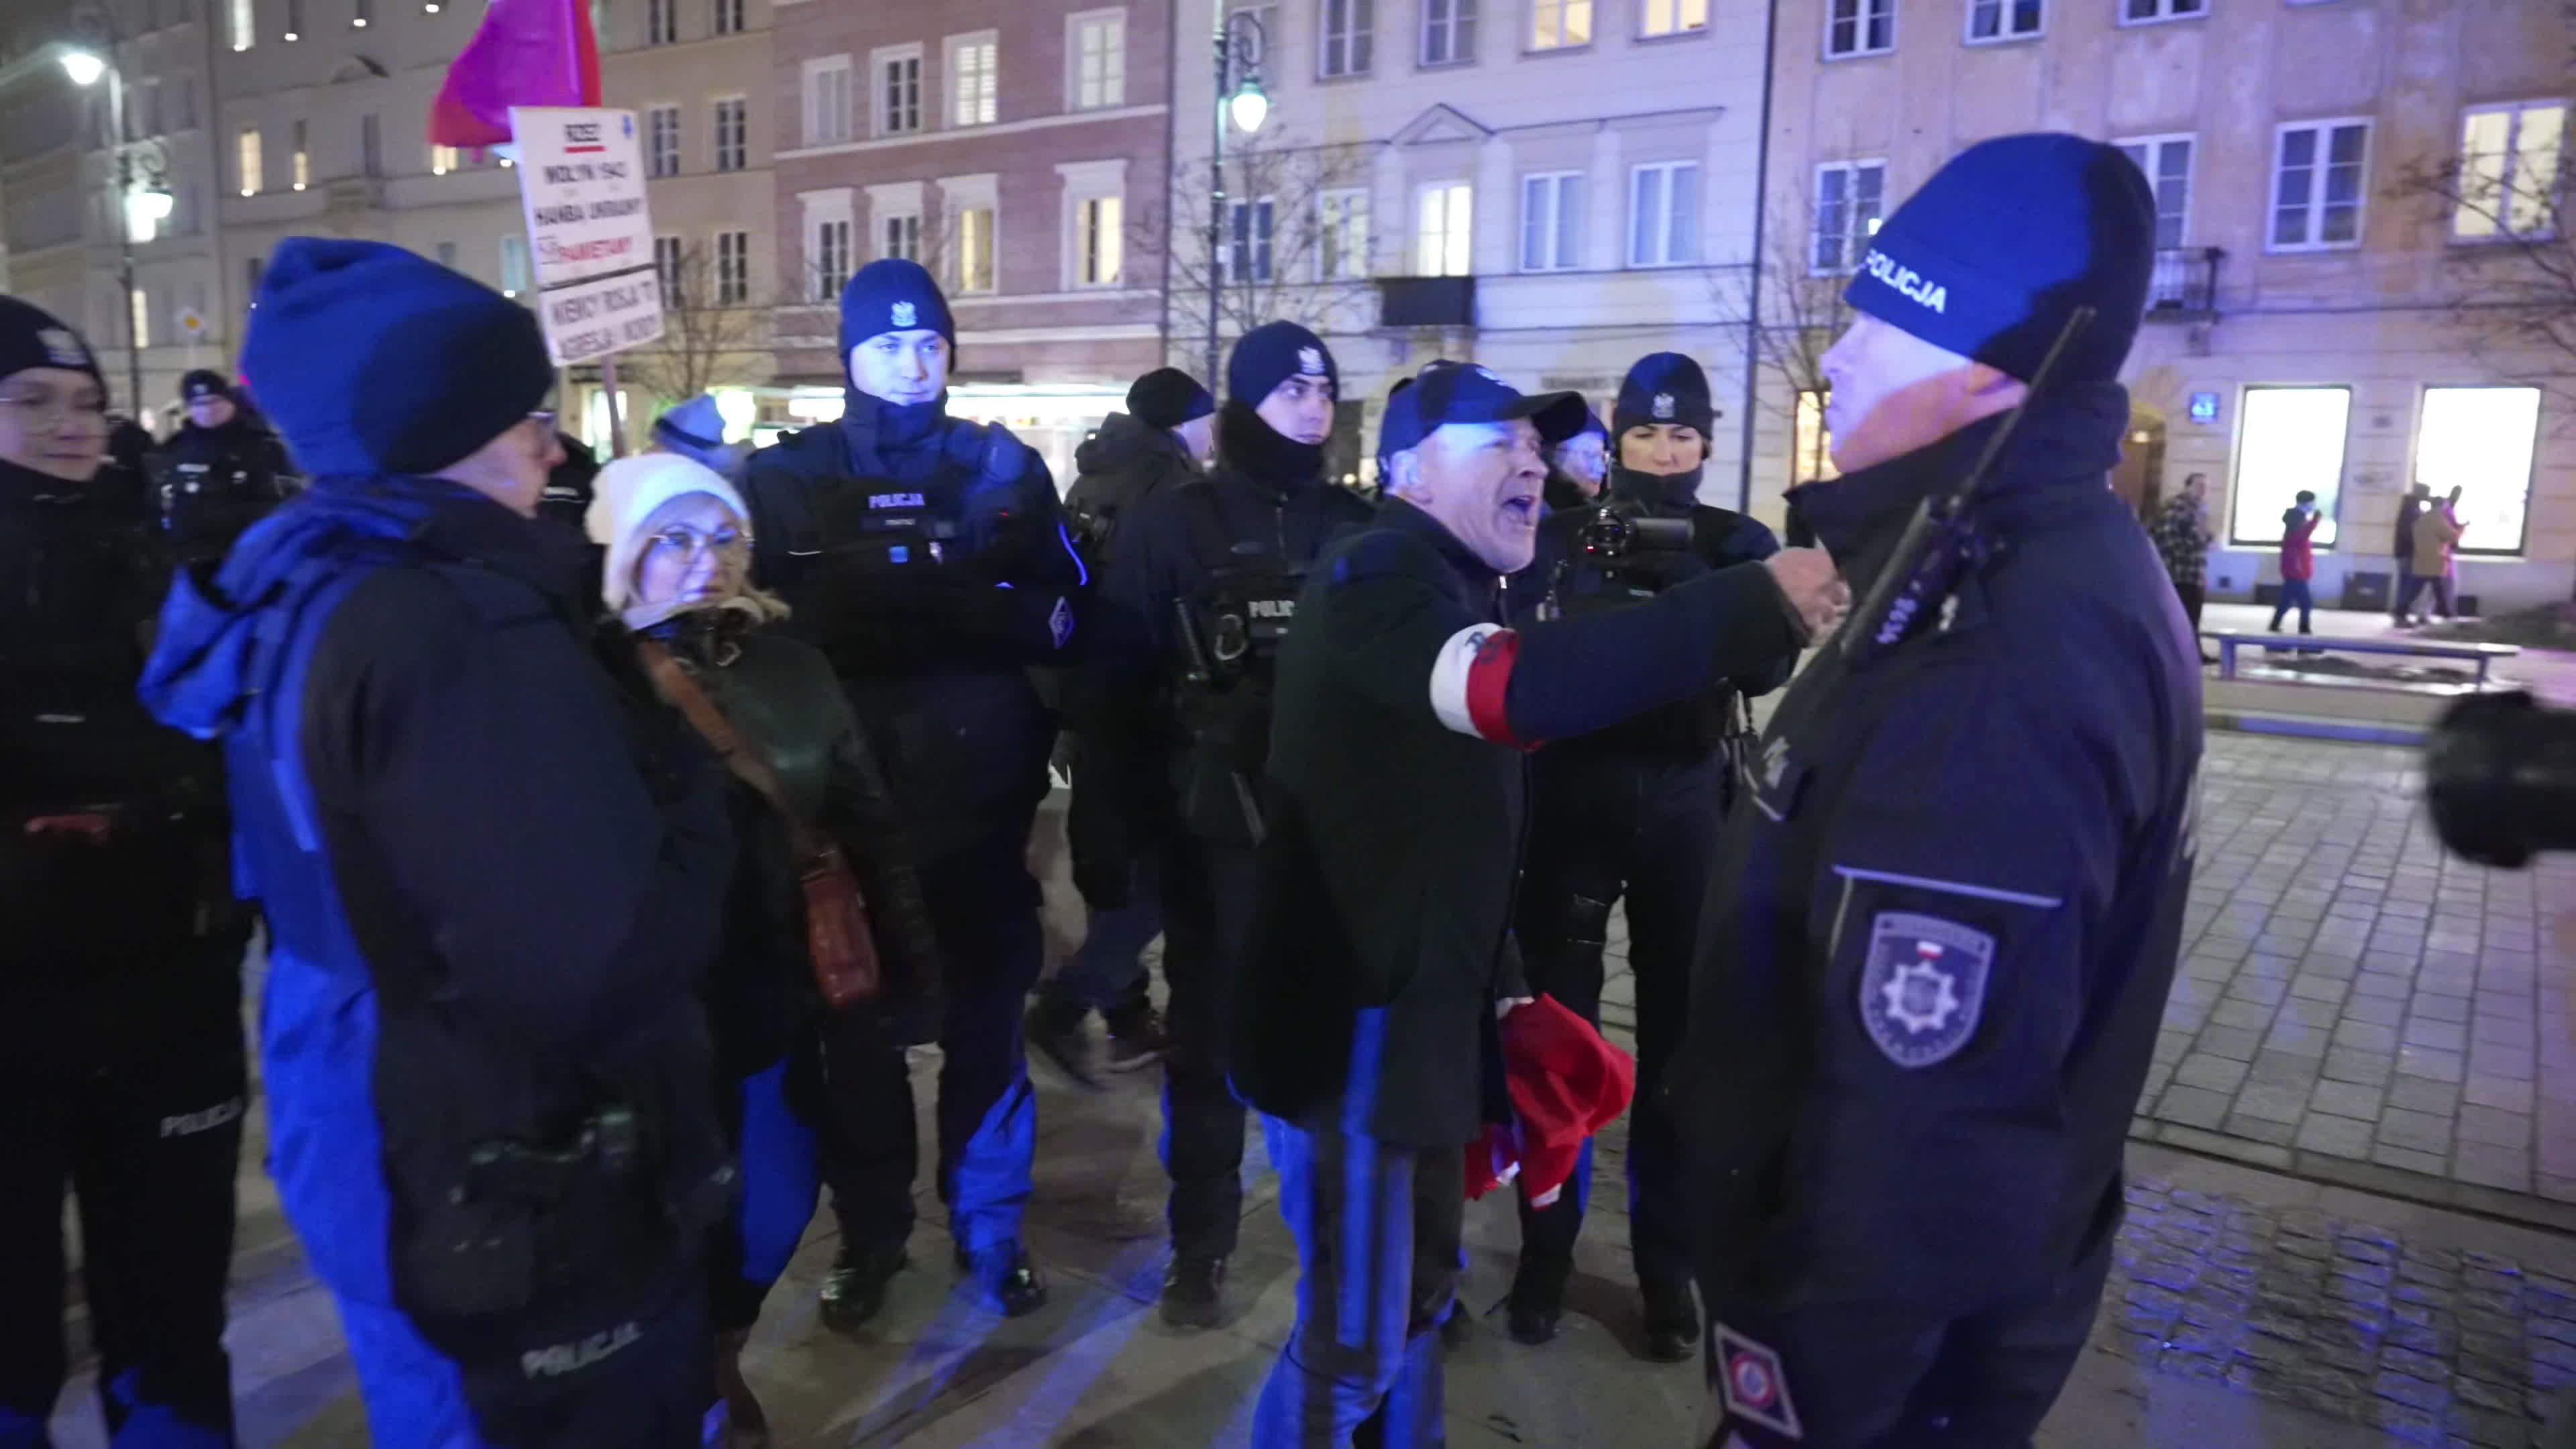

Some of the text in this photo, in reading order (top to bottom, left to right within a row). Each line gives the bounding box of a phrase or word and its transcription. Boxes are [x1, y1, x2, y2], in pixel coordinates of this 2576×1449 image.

[1865, 248, 1947, 314] POLICJA
[868, 492, 925, 508] POLICJA
[1248, 600, 1295, 618] POLIC
[521, 1320, 644, 1380] POLICJA
